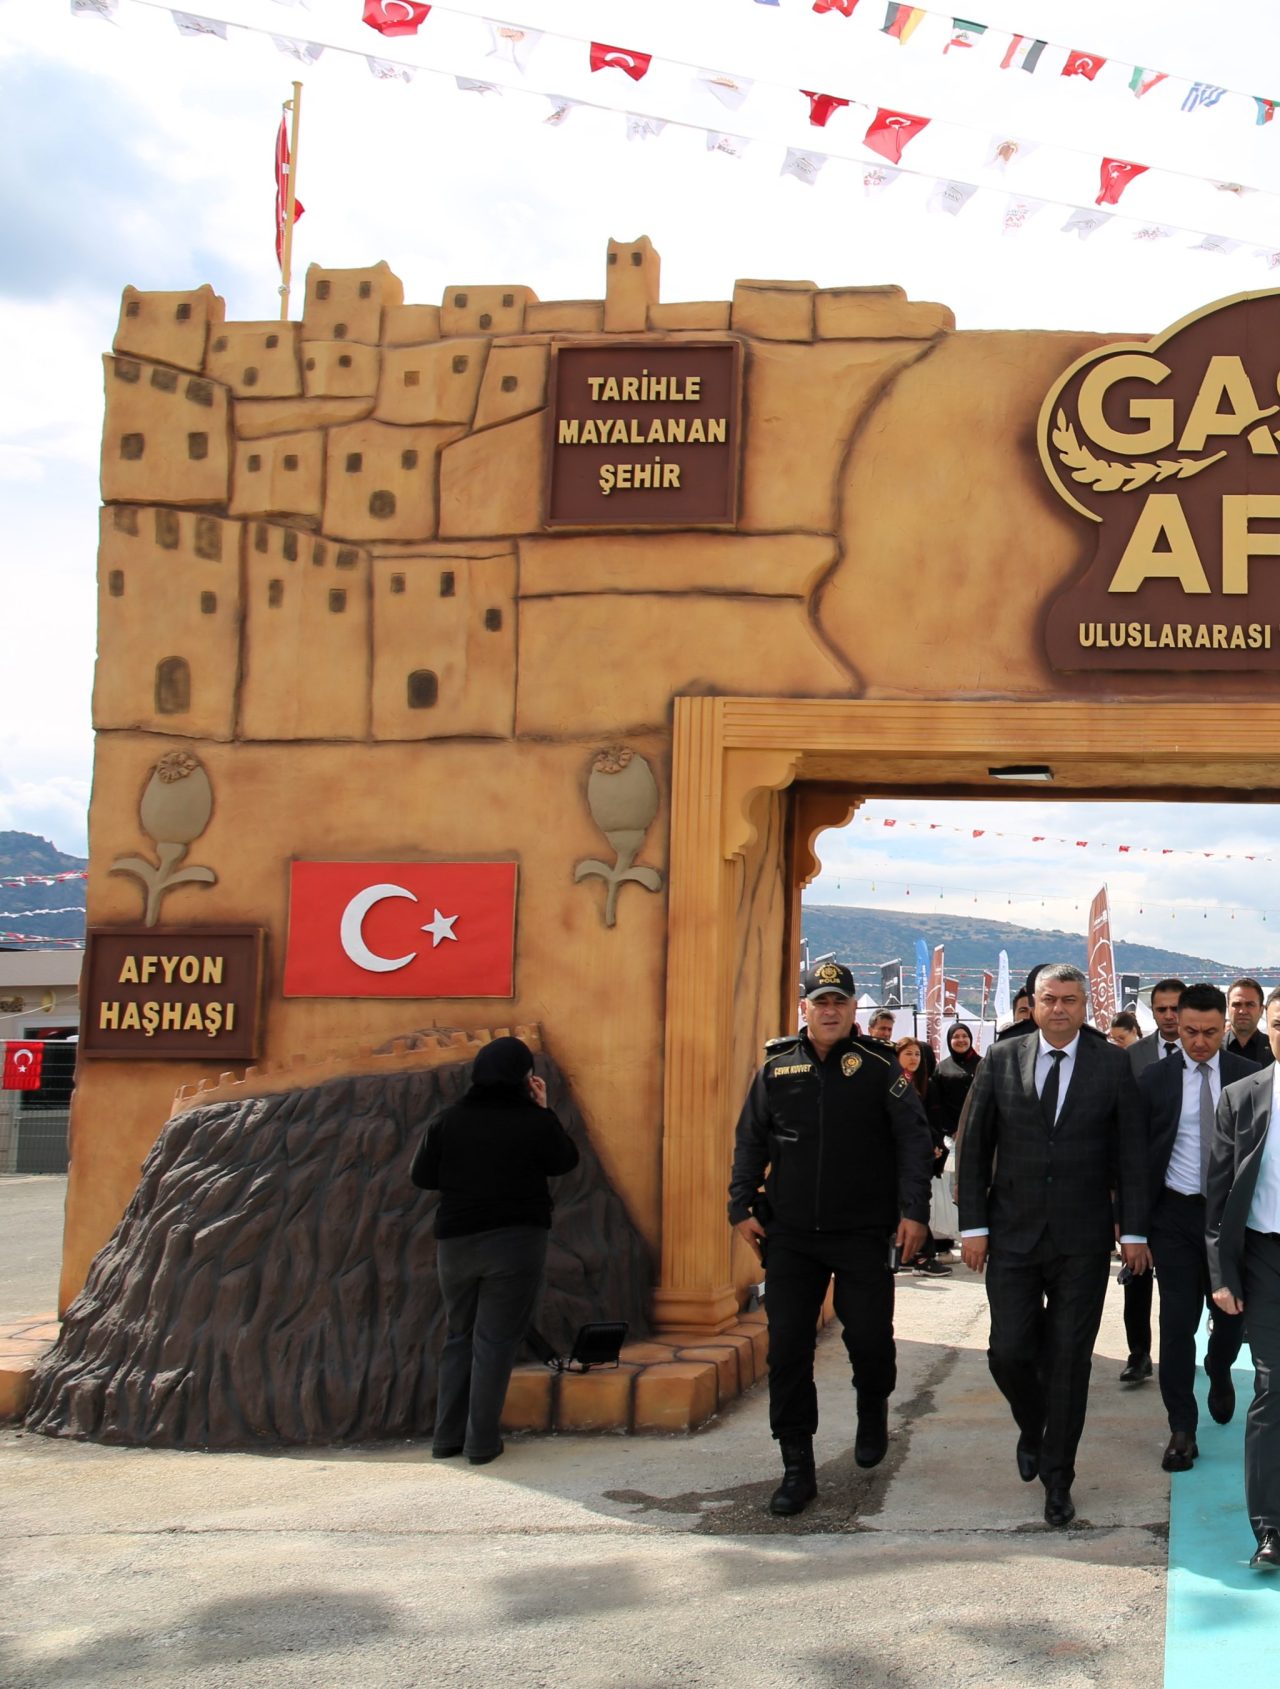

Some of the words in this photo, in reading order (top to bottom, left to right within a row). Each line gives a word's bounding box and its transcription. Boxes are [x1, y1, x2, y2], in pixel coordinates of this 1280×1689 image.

[587, 369, 701, 401] TARİHLE
[558, 418, 727, 444] MAYALANAN
[599, 456, 681, 495] ŞEHİR
[1079, 622, 1270, 650] ULUSLARARASI
[118, 955, 223, 984] AFYON
[99, 1001, 235, 1038] HAŞHAŞI
